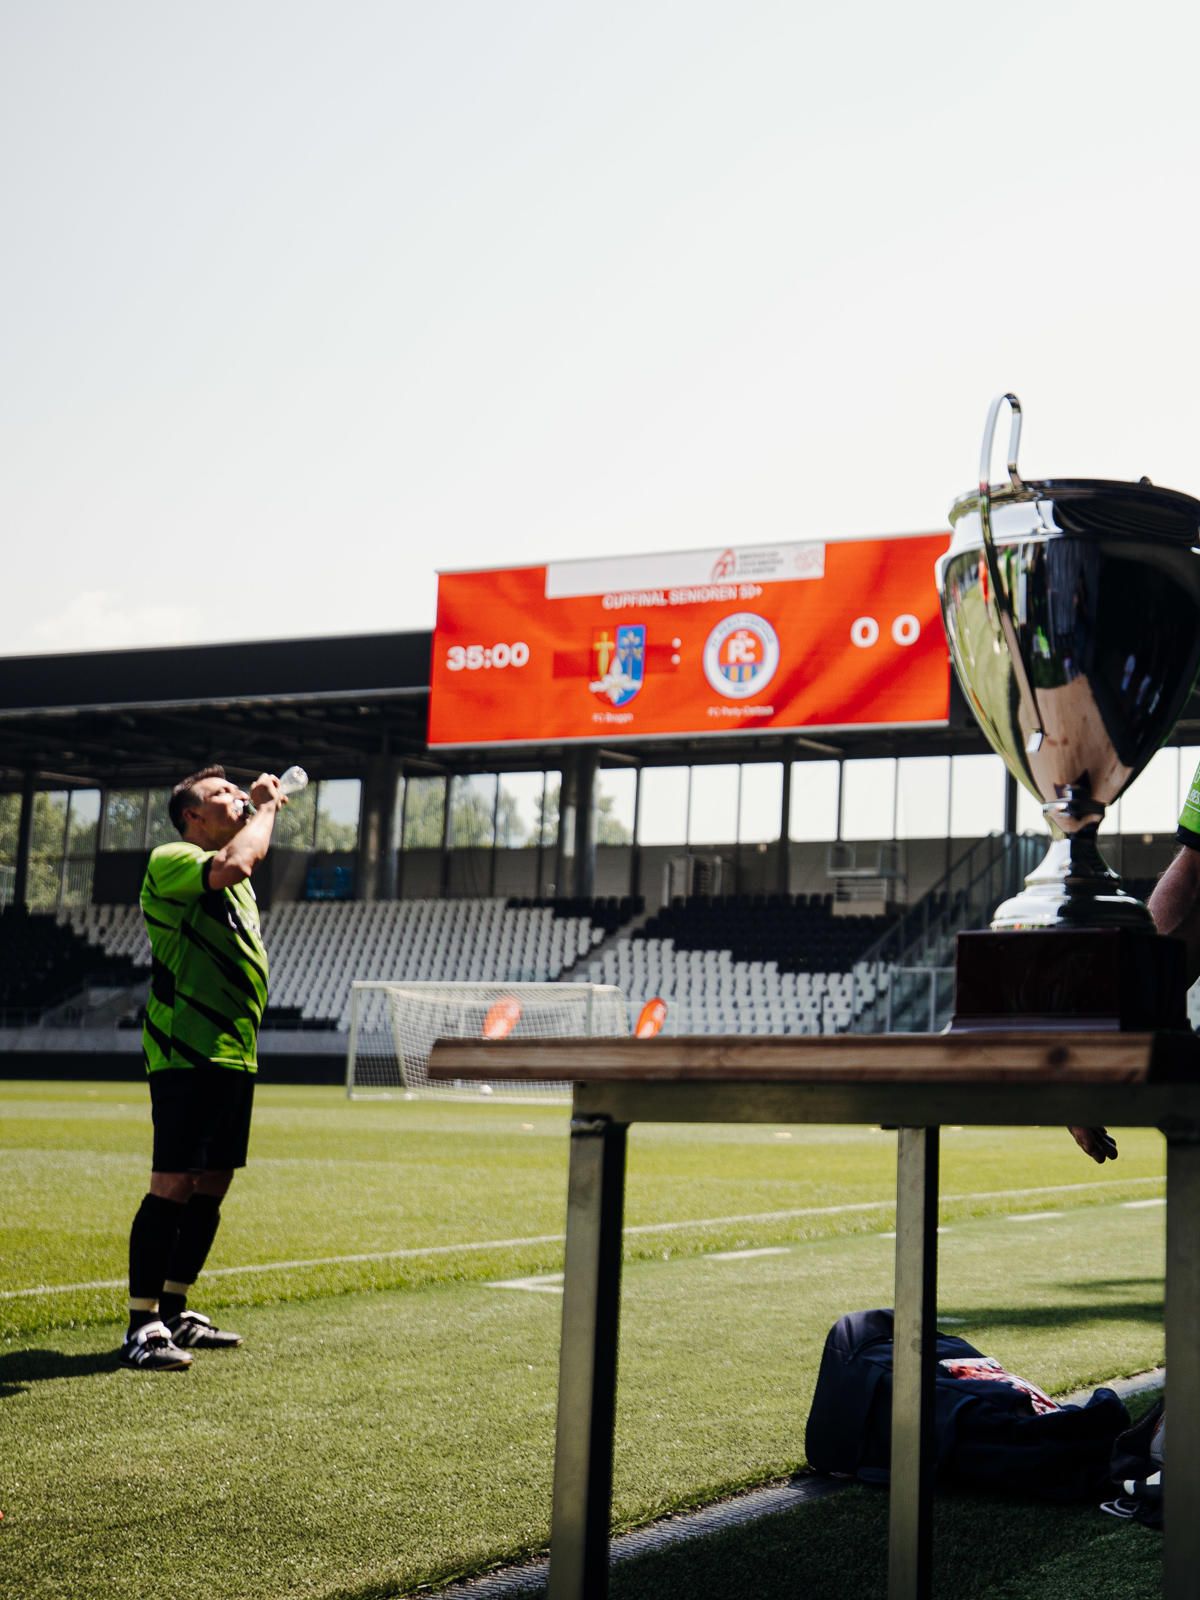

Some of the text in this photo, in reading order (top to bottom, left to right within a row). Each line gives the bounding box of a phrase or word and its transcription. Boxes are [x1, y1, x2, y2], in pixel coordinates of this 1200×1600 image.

[602, 590, 667, 610] CUPFINAL
[668, 585, 738, 606] SENIOREN
[850, 613, 921, 649] 0 0
[446, 641, 530, 672] 35:00
